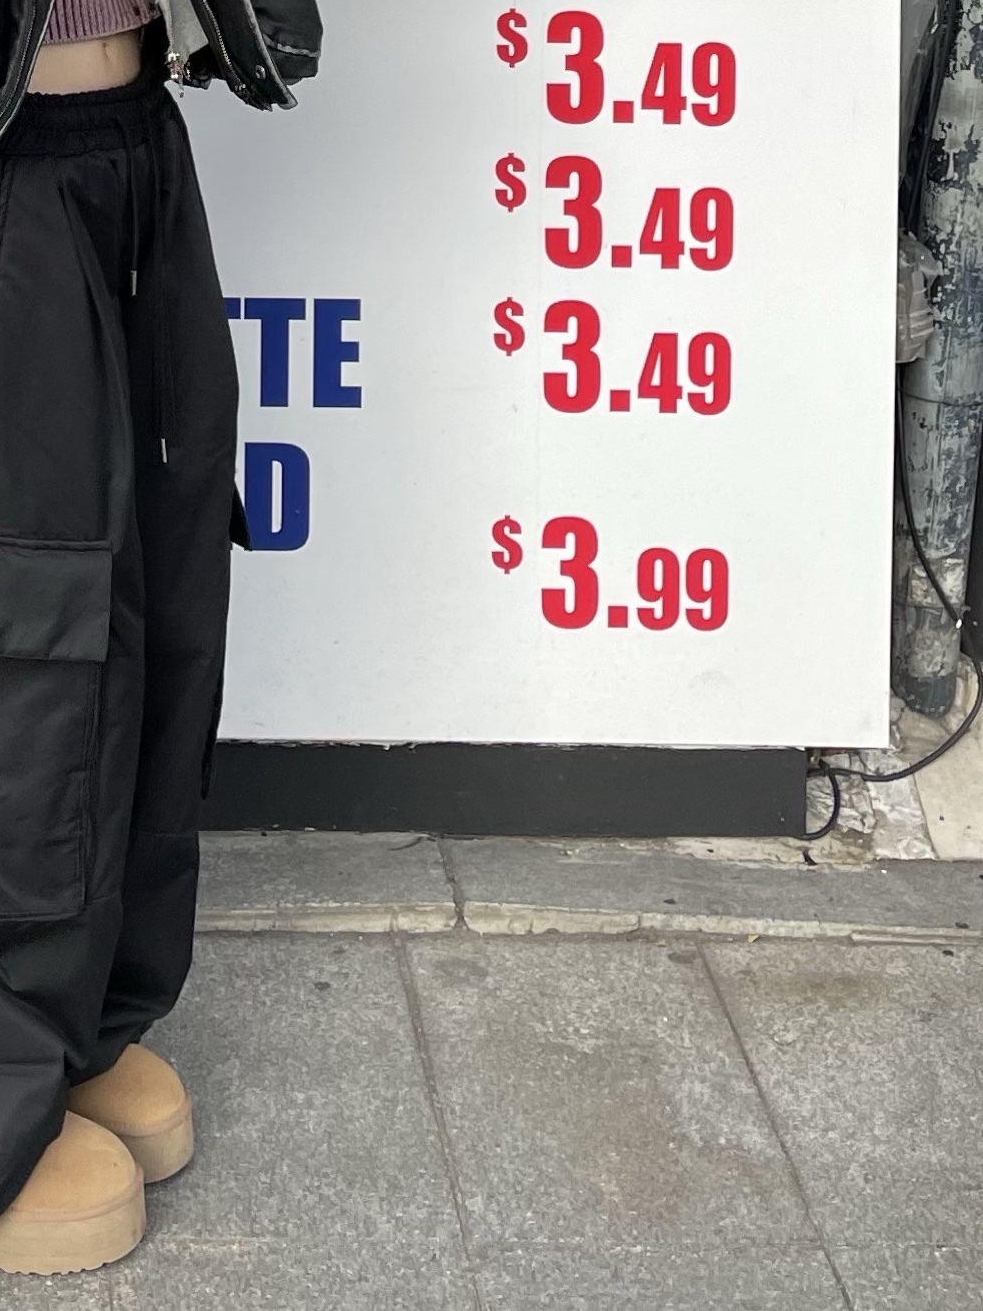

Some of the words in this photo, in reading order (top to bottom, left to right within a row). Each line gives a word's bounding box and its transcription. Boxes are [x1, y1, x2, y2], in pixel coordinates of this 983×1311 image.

[495, 8, 738, 128] $3.49
[494, 153, 735, 272] $3.49
[493, 297, 733, 416] $3.49
[491, 515, 731, 633] $3.99
